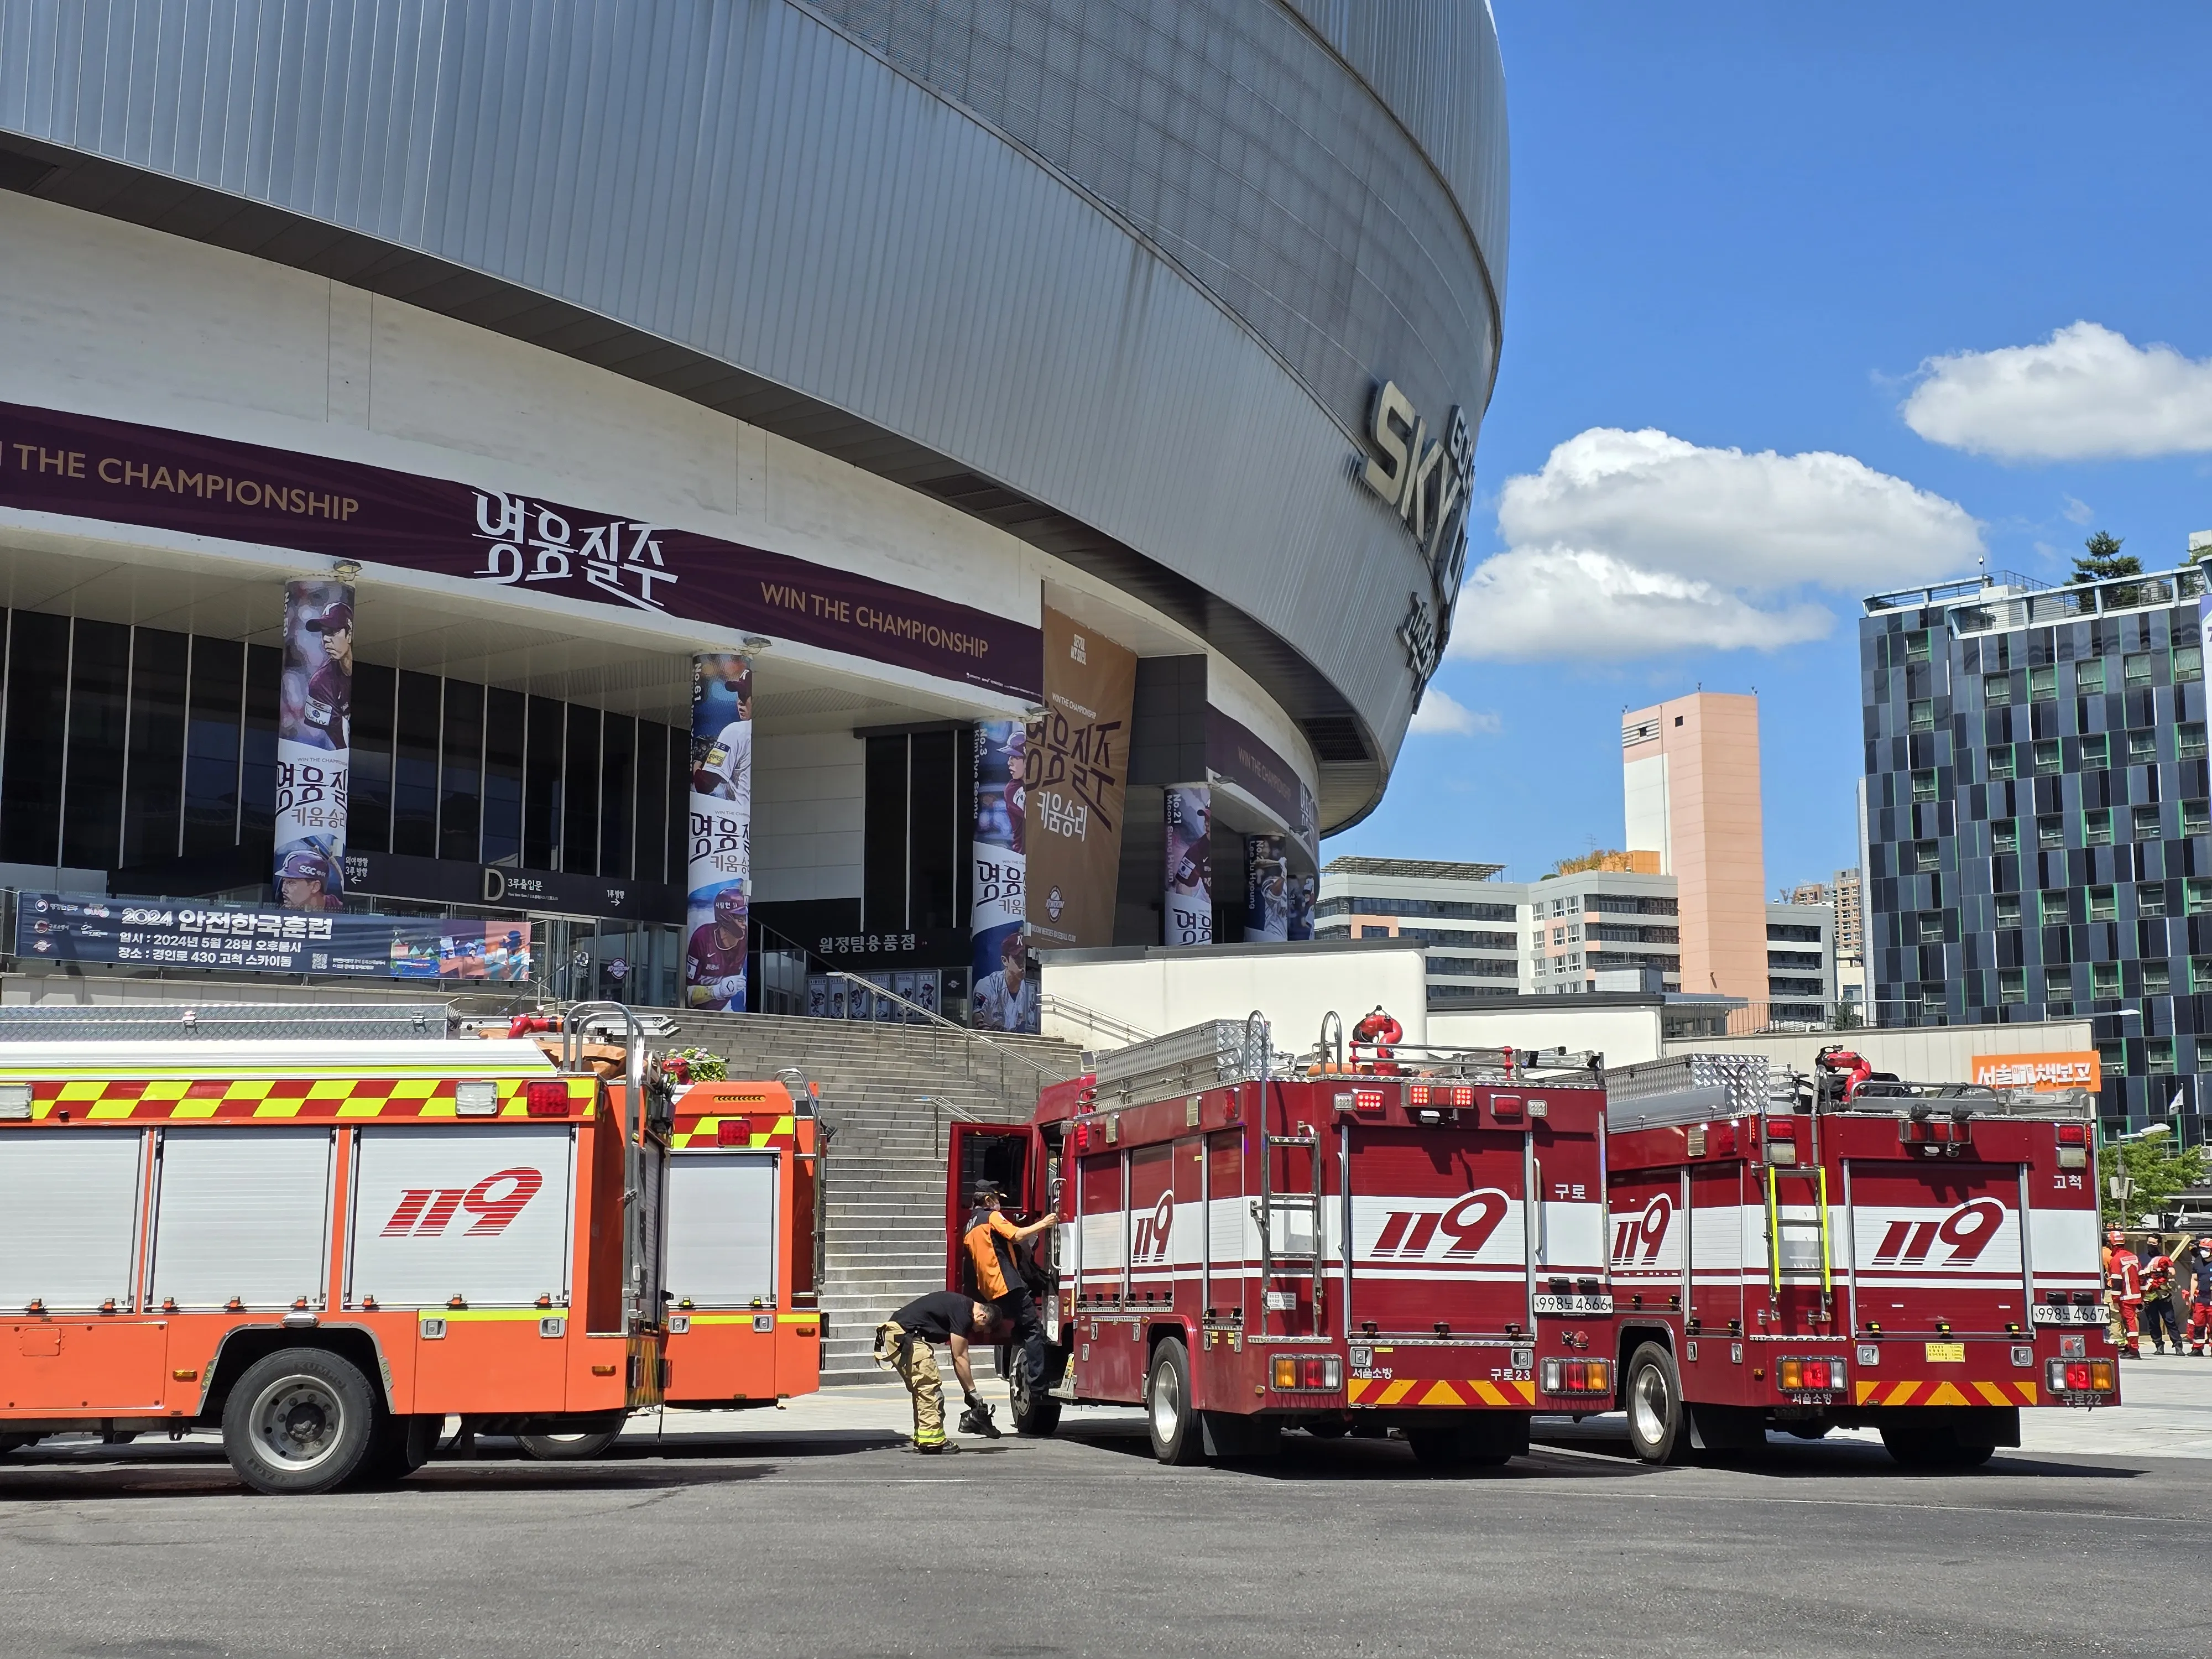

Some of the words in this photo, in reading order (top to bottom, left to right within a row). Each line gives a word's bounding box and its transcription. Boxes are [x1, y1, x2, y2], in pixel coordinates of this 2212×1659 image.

[14, 444, 85, 478] THE
[98, 458, 358, 521] CHAMPIONSHIP
[1359, 380, 1460, 561] SKY
[472, 487, 678, 617] 영웅질주
[760, 582, 805, 612] WIN
[811, 596, 850, 623] THE
[856, 607, 988, 659] CHAMPIONSHIP
[1052, 692, 1061, 703] WIN
[1060, 697, 1069, 707] THE
[1069, 701, 1097, 719] CHAMPIONSHIP
[1037, 791, 1088, 842] 키움승리
[1173, 794, 1182, 824] No.21
[299, 865, 316, 875] SGC
[346, 867, 356, 875] 3루
[357, 868, 368, 877] 방향
[484, 868, 505, 901] D
[122, 907, 174, 927] 2024
[178, 910, 333, 940] 안전한국훈련
[120, 932, 143, 943] 일시
[153, 933, 198, 948] 2024년
[201, 937, 221, 949] 5월
[225, 938, 252, 951] 28일
[818, 934, 916, 953] 원정팀용품점
[118, 947, 143, 959] 장소
[153, 949, 189, 963] 경인로
[191, 953, 216, 963] 430
[220, 953, 243, 965] 고척
[246, 954, 292, 967] 스카이돔
[1555, 1184, 1587, 1199] 구로
[2053, 1175, 2082, 1190] 고척
[379, 1166, 542, 1238] 119
[1132, 1189, 1174, 1264] 119
[1370, 1188, 1511, 1259] 119
[1611, 1193, 1673, 1266] 119
[1871, 1197, 2006, 1267] 119
[1540, 1297, 1573, 1310] 998노
[1576, 1297, 1608, 1311] 4666
[2038, 1307, 2070, 1321] 998노
[2074, 1307, 2105, 1321] 4667
[1353, 1368, 1393, 1379] 서울소방
[1491, 1369, 1531, 1381] 구로23
[1792, 1393, 1833, 1405] 서울소방
[2063, 1394, 2102, 1406] 구로22
